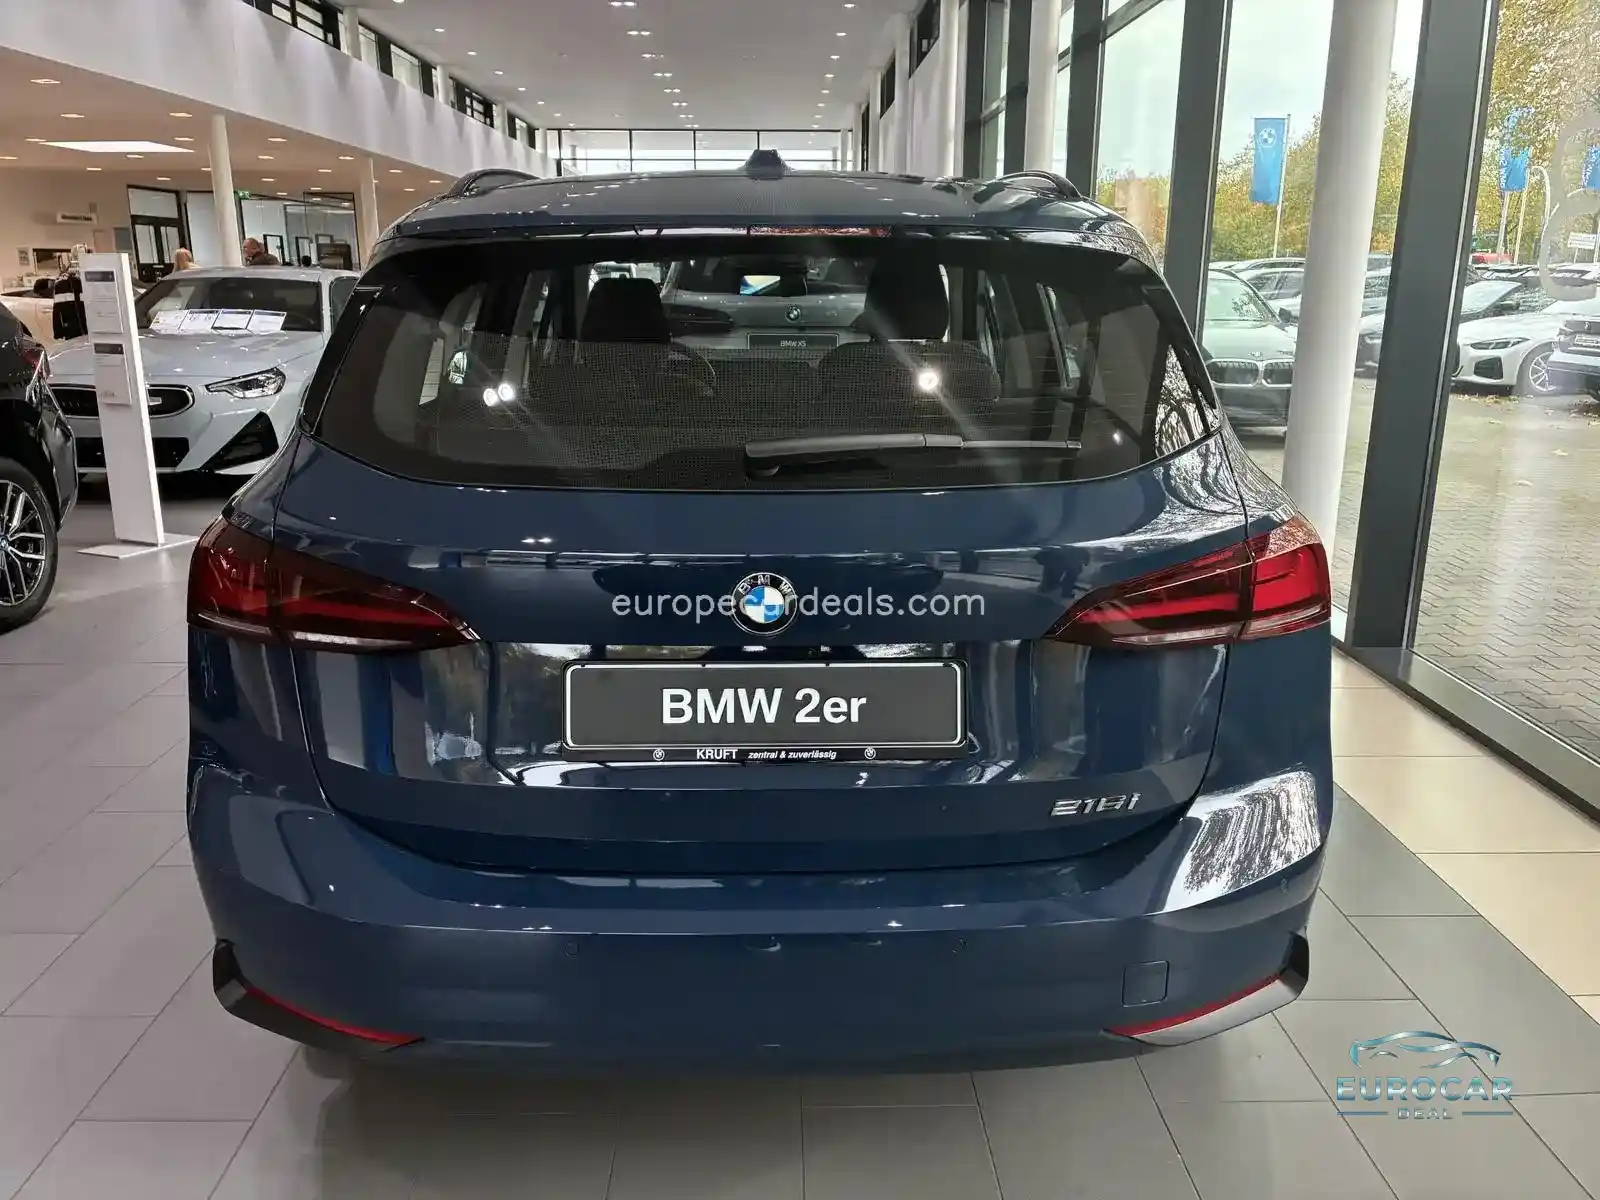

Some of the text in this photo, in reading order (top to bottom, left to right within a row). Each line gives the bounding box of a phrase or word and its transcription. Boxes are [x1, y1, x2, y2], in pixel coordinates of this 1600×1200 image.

[738, 574, 795, 596] BMW
[661, 687, 867, 724] BMW 2er
[696, 749, 837, 760] KRUFT zentral & zuverlässig
